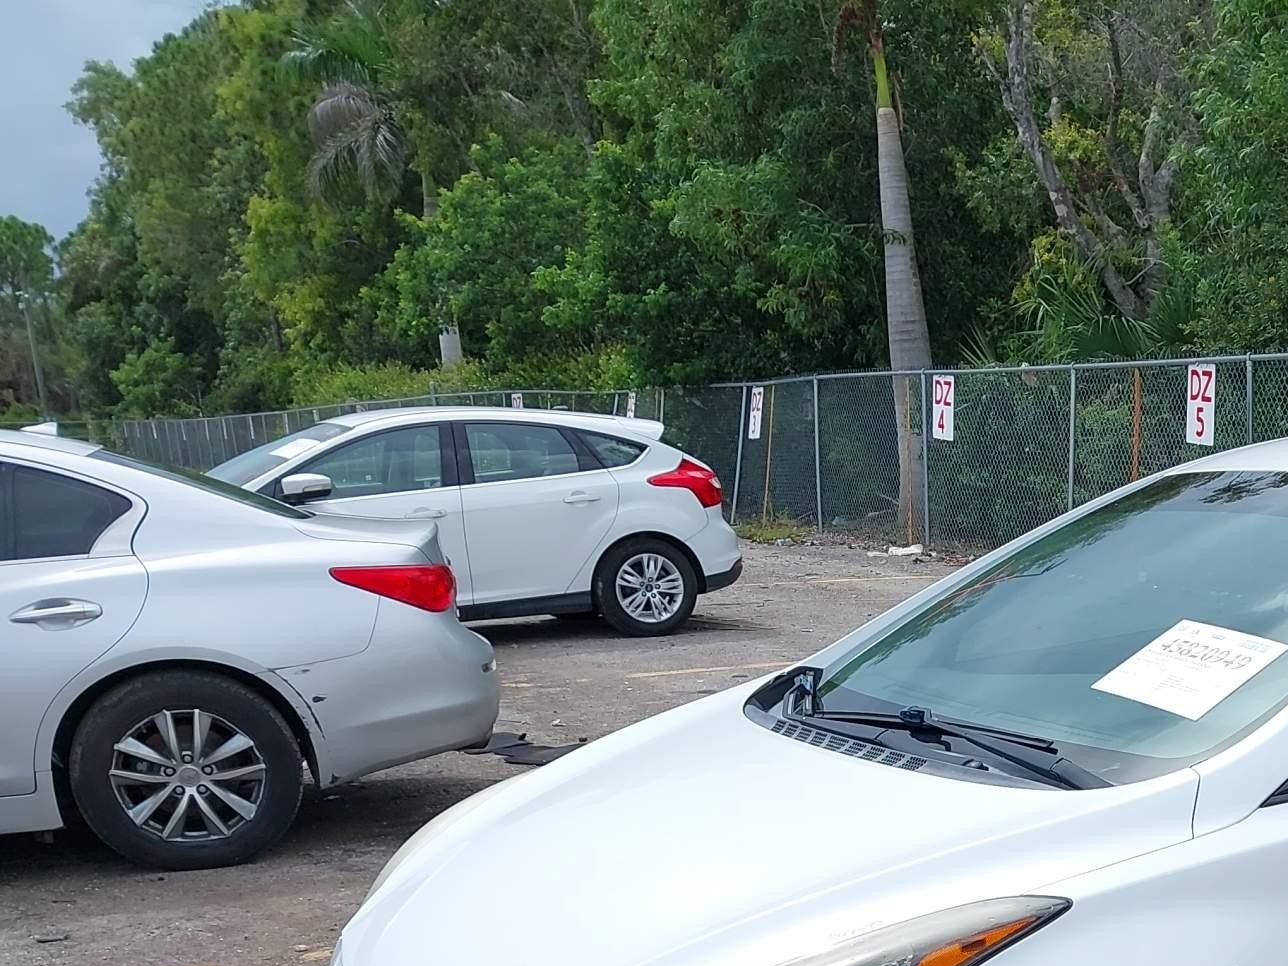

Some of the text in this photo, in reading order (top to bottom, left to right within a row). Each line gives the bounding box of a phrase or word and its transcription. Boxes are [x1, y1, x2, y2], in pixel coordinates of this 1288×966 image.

[935, 380, 952, 406] DZ
[1190, 369, 1212, 402] DZ
[752, 391, 762, 411] DZ
[938, 410, 944, 433] 4
[1196, 407, 1204, 437] 5
[1161, 638, 1253, 669] 45820949
